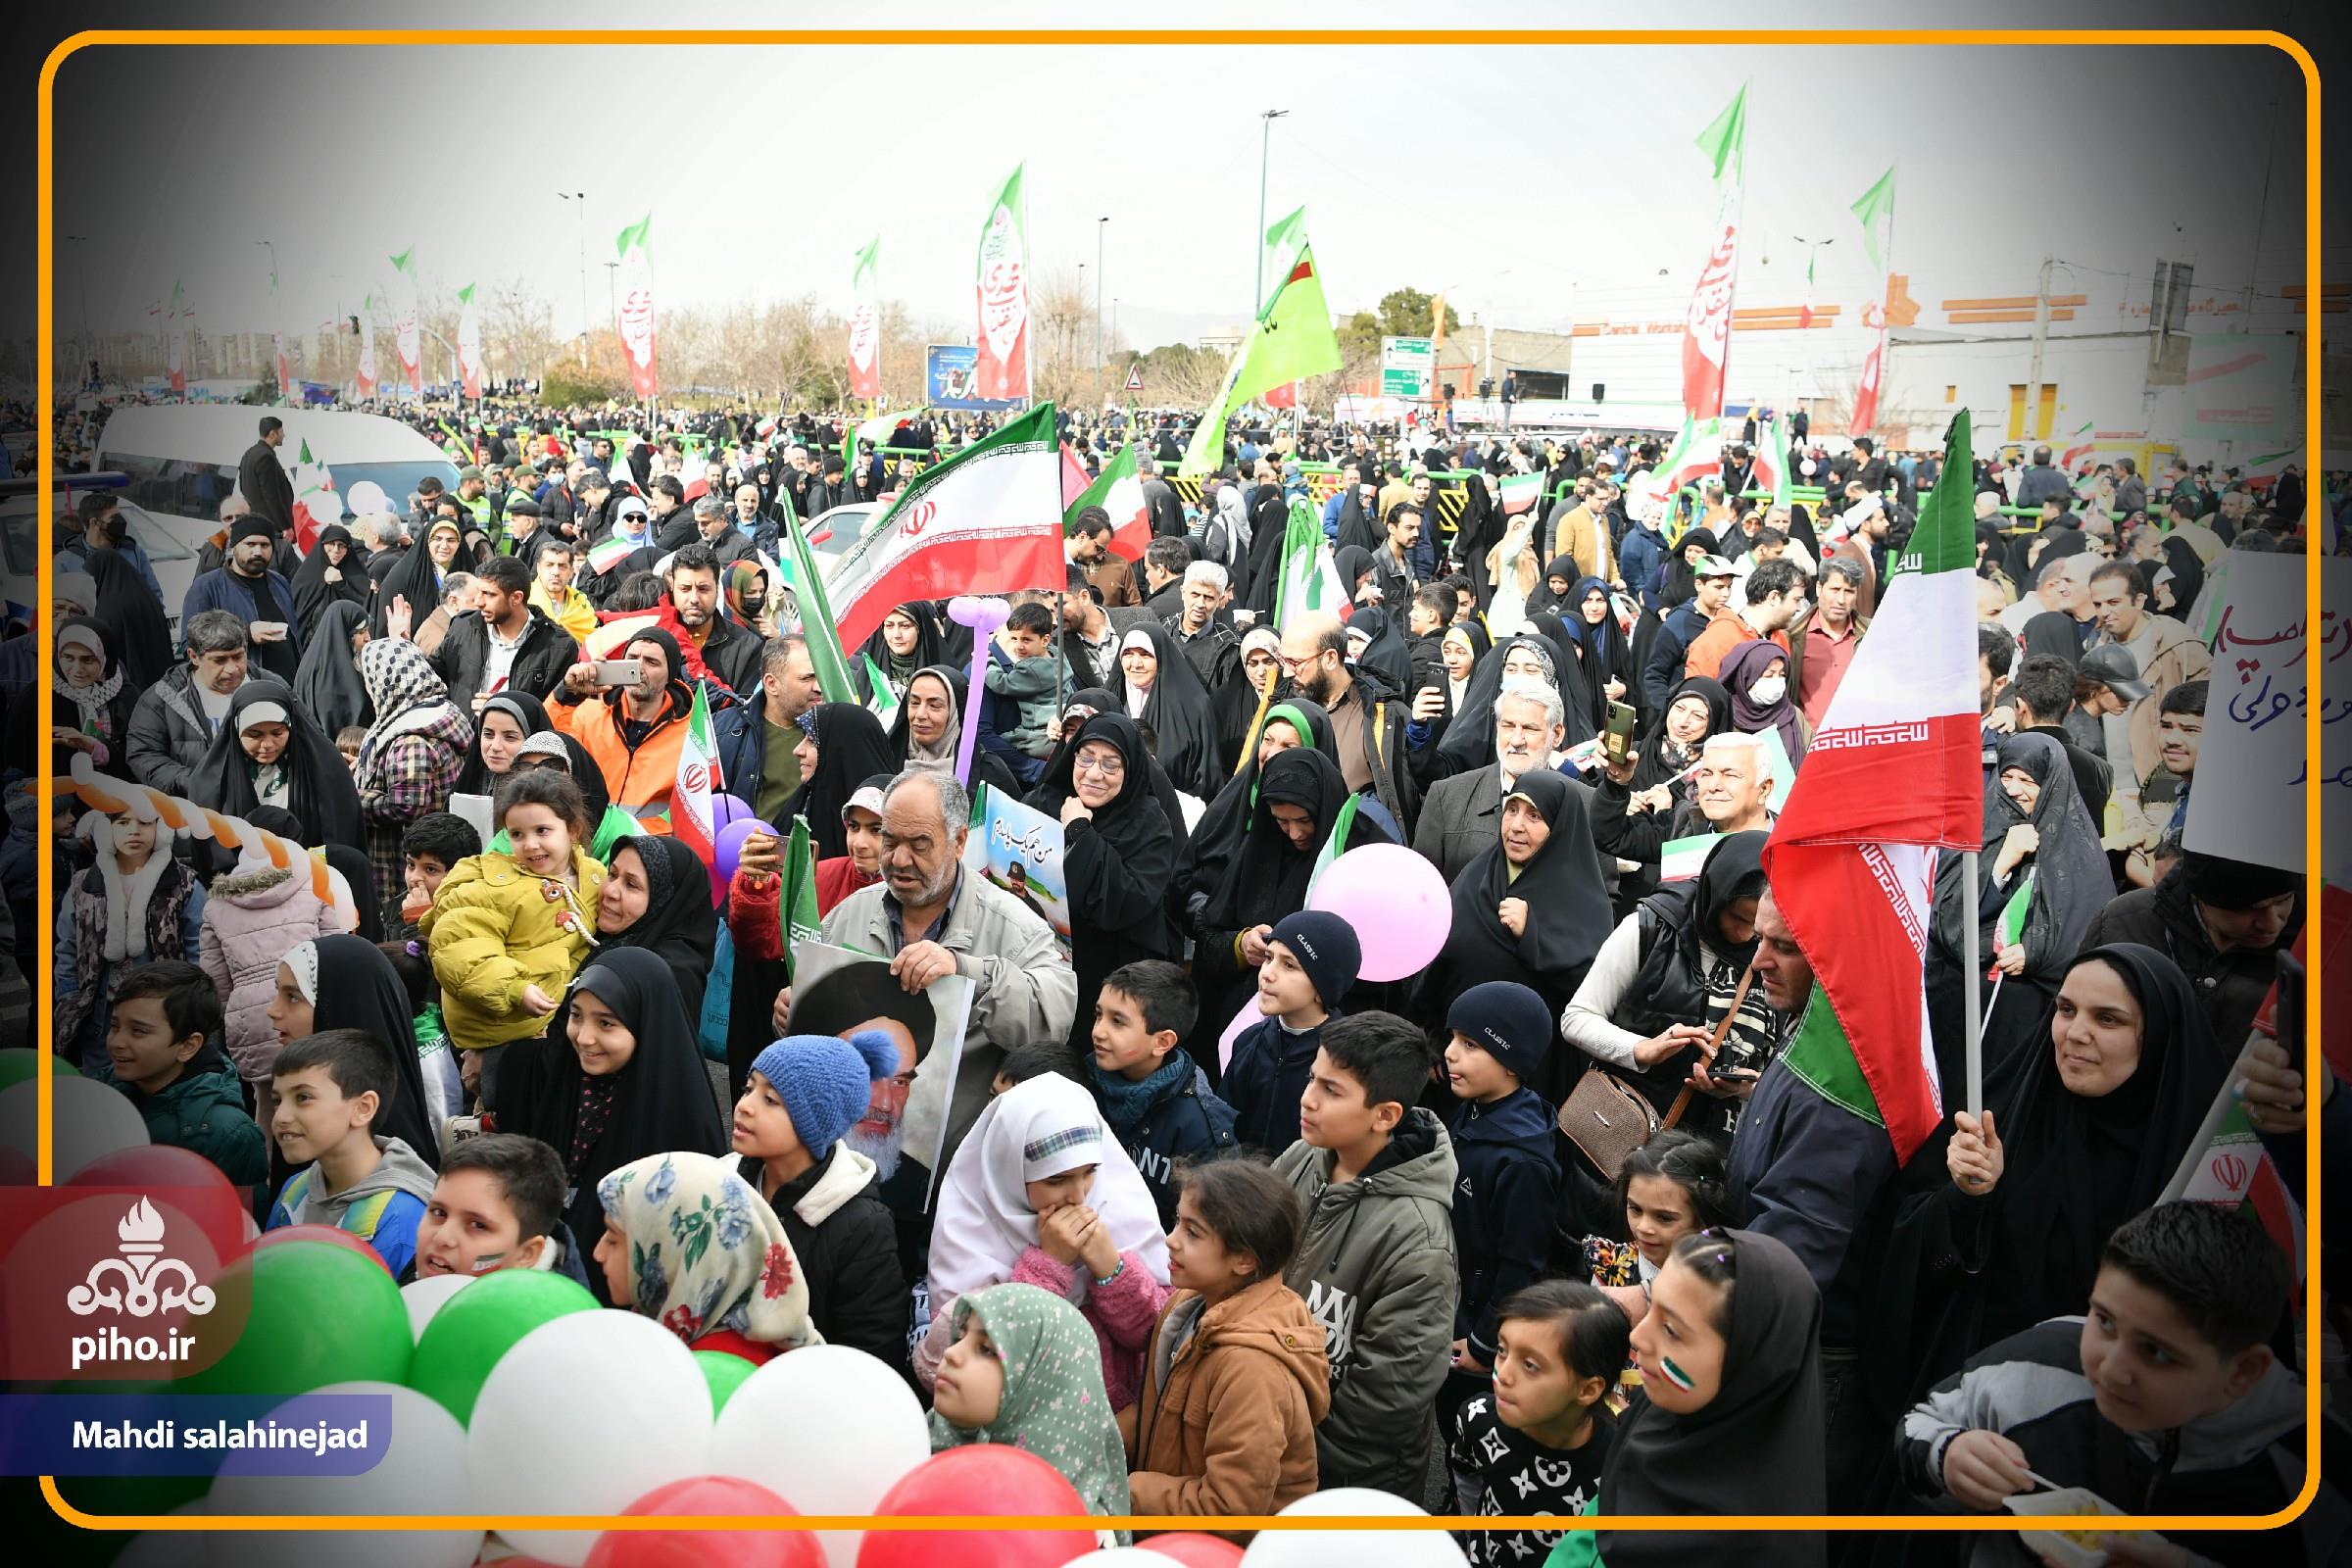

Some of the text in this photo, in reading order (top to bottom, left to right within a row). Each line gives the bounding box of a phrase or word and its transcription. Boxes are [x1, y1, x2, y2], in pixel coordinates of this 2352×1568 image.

[1011, 825, 1044, 853] یک
[1026, 838, 1041, 868] هم
[1034, 848, 1053, 863] من
[1297, 933, 1319, 961] CLASSIC
[1484, 1026, 1511, 1051] CLASSIC
